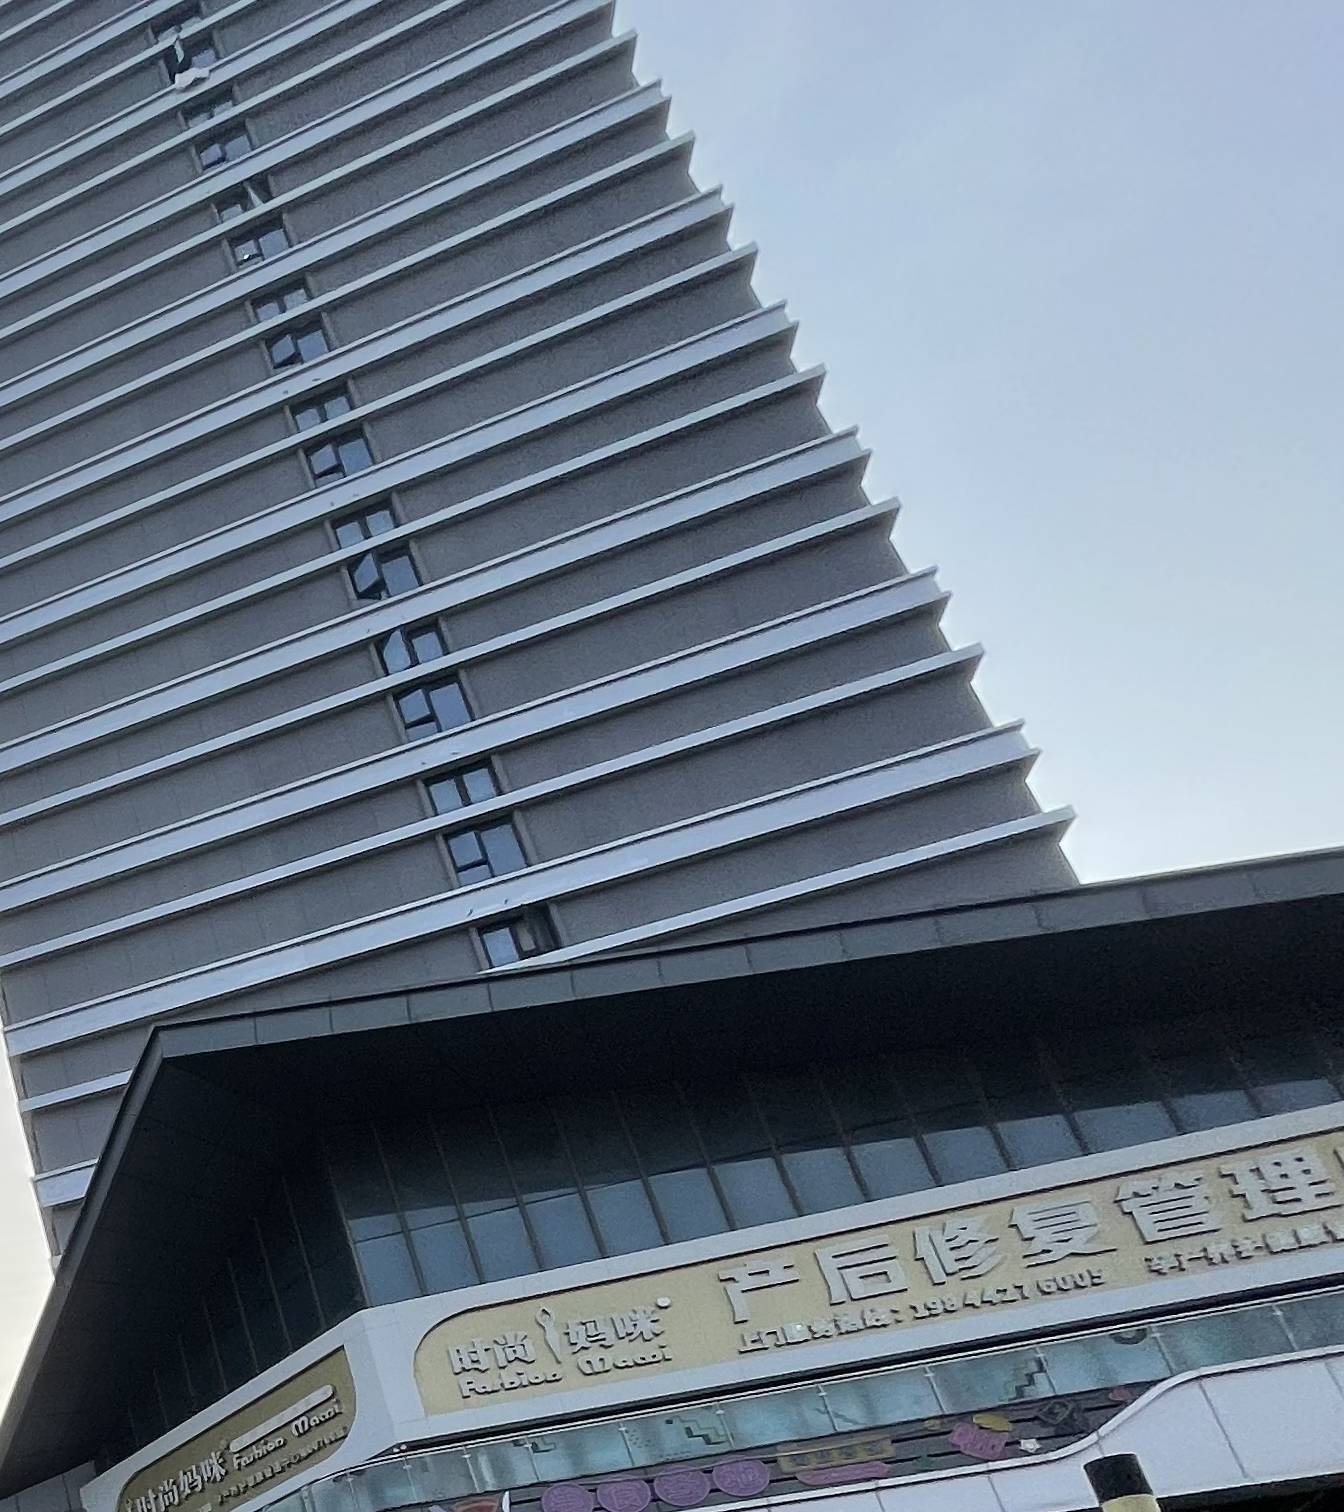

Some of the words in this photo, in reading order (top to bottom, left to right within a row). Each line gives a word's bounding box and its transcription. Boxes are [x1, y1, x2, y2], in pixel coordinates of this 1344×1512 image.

[717, 1146, 1344, 1326] 产后修复管理
[446, 1306, 670, 1376] 时尚妈咪
